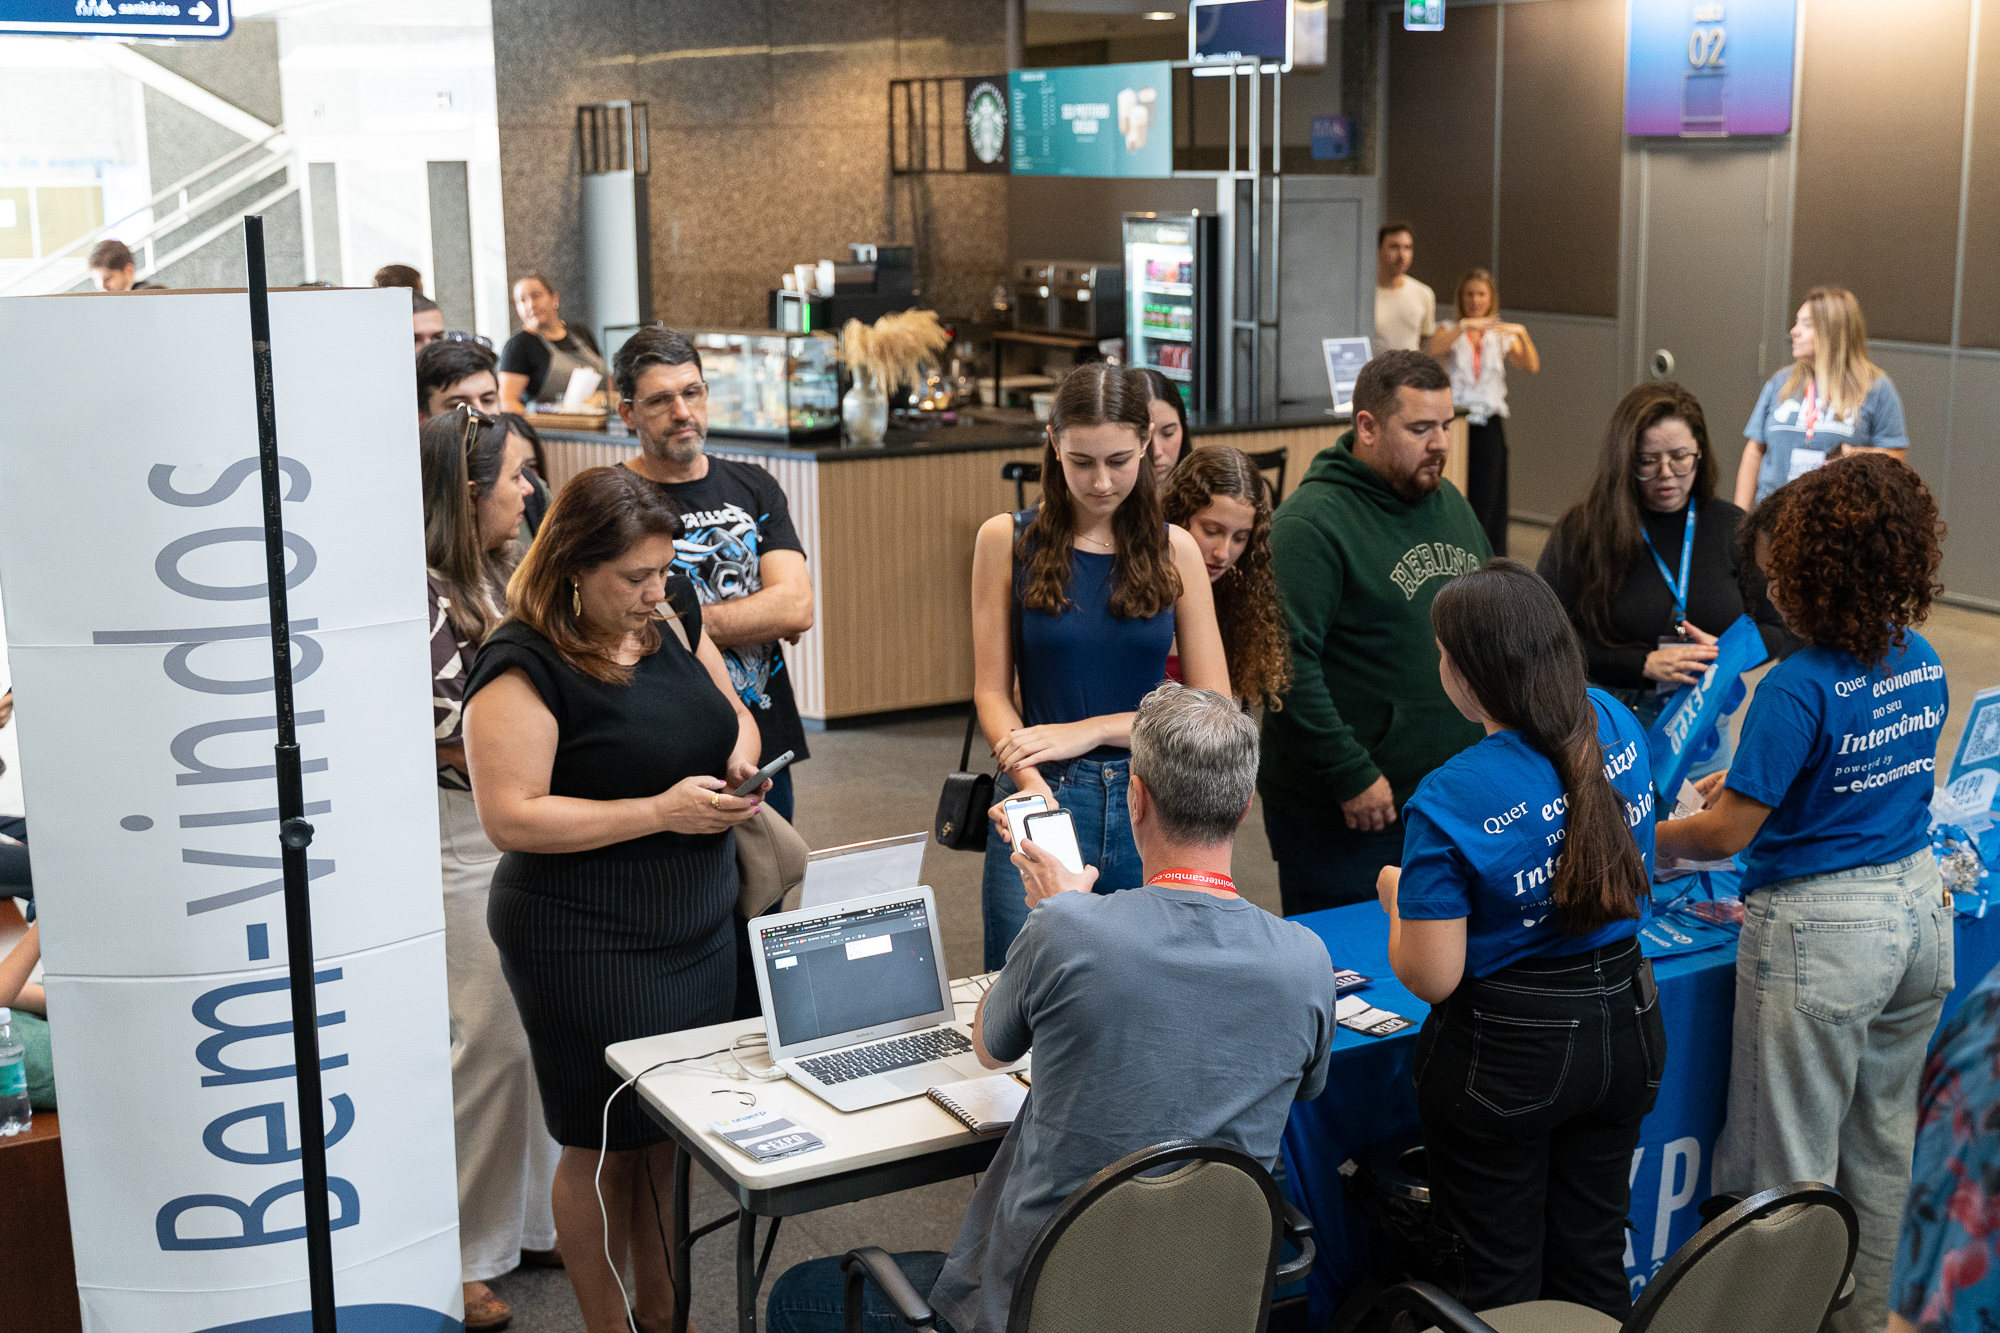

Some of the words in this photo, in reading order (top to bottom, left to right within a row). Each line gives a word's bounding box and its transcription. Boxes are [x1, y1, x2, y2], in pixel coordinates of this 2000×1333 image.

[1689, 27, 1727, 68] 02
[1834, 675, 1867, 698] Quer
[1873, 704, 1886, 719] no
[1886, 699, 1902, 715] seu
[1483, 801, 1529, 835] Quer
[1546, 828, 1566, 847] no
[93, 456, 360, 1251] Bem-vindos
[768, 1134, 803, 1148] EXPO
